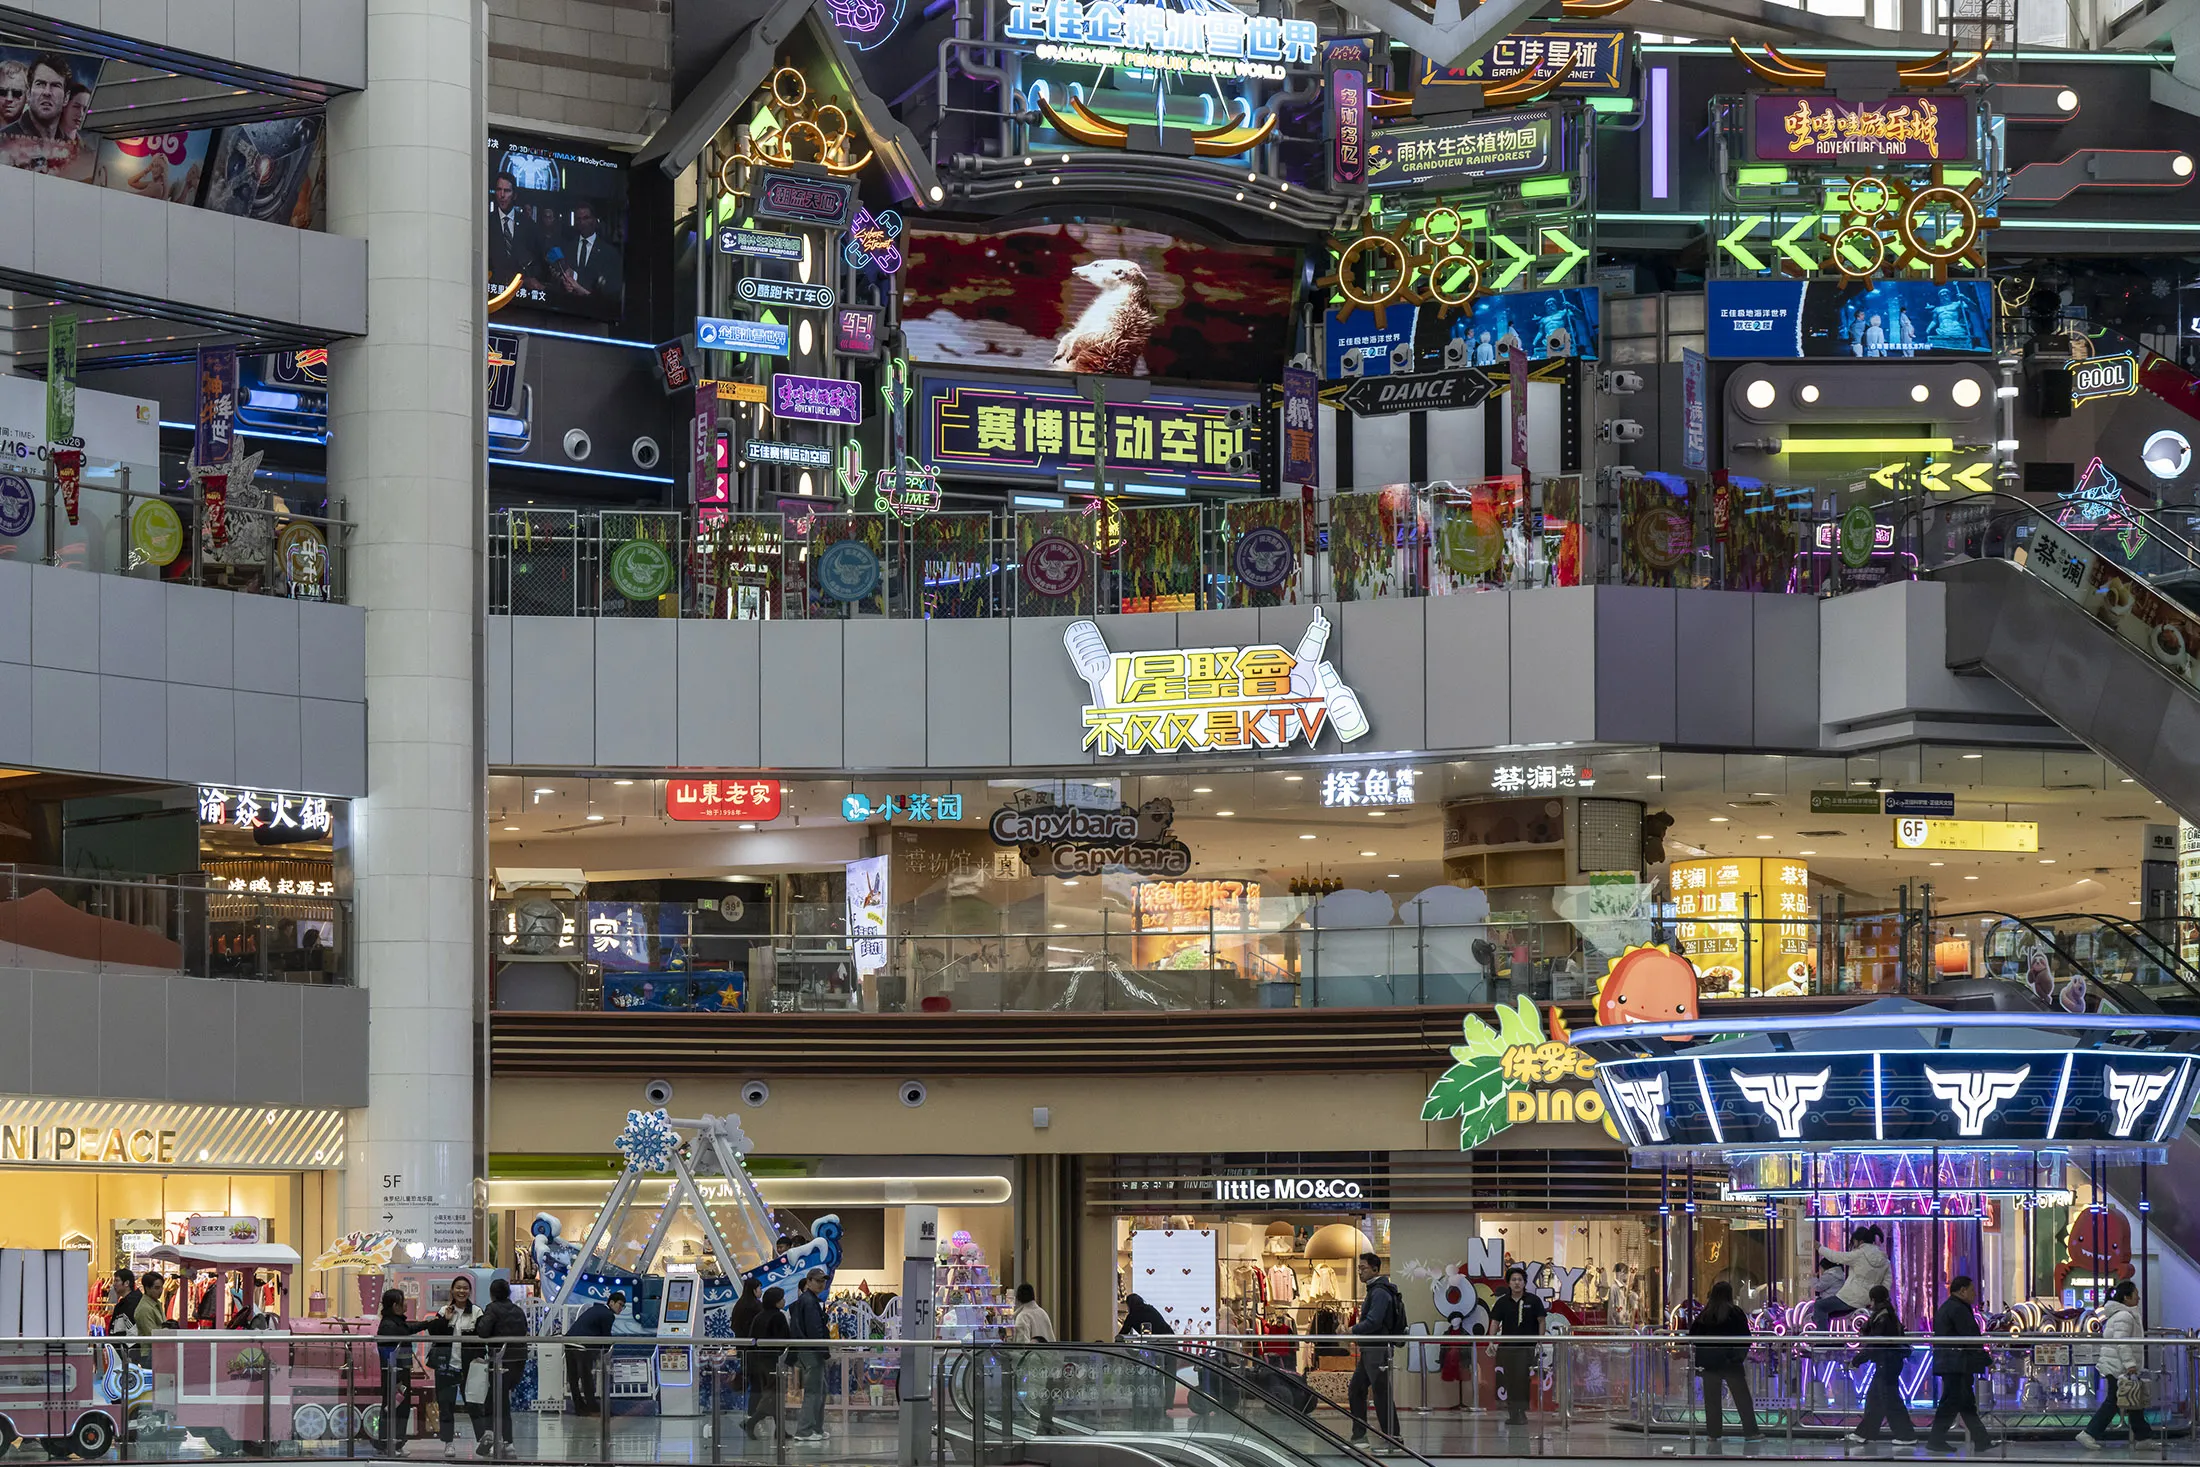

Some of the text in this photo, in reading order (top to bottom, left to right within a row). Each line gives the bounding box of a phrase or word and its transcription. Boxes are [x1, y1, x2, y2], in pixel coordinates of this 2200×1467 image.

[1004, 0, 1318, 64] 正佳企鹅冰雪世界
[1036, 44, 1287, 81] GRANDVIEW PENGUIN SNOW WORLD
[1784, 98, 1939, 158] 哇哇哇游乐城
[1396, 128, 1537, 163] 雨林生态植物园
[1879, 142, 1907, 155] LAND
[1402, 150, 1532, 173] GRANDVIEW RAINFOREST
[774, 187, 838, 211] 潮流天地
[756, 283, 817, 303] 酷跑卡丁车
[1720, 308, 1788, 319] 正佳极地海洋世界
[718, 325, 786, 346] 企鹅冰雪世界
[1338, 333, 1401, 348] 正佳极地海洋世界
[2077, 365, 2125, 390] COOL
[777, 379, 857, 421] 哇哇哇游乐城
[1379, 378, 1455, 403] DANCE
[794, 404, 841, 417] ADVENTURE LAND
[976, 405, 1244, 465] 赛博运动空间
[749, 443, 831, 465] 正佳赛博运动空间
[887, 476, 926, 491] HPPY
[1116, 649, 1298, 704] 星聚會
[1085, 706, 1328, 752] 不仅仅是KTV
[1322, 768, 1393, 806] 探魚
[1491, 766, 1557, 792] 蔡澜
[676, 781, 772, 805] 山東老家
[876, 792, 963, 822] 小菜园
[993, 807, 1139, 842] Capybara
[1902, 820, 1924, 838] 6F
[2154, 834, 2174, 847] 中庭
[1053, 844, 1188, 874] Capybara
[1507, 1088, 1606, 1123] DINO
[52, 1127, 177, 1164] PEACE
[383, 1174, 402, 1189] 5F
[1216, 1179, 1270, 1200] little
[1274, 1178, 1364, 1200] MO&Co.
[914, 1307, 930, 1326] 5F
